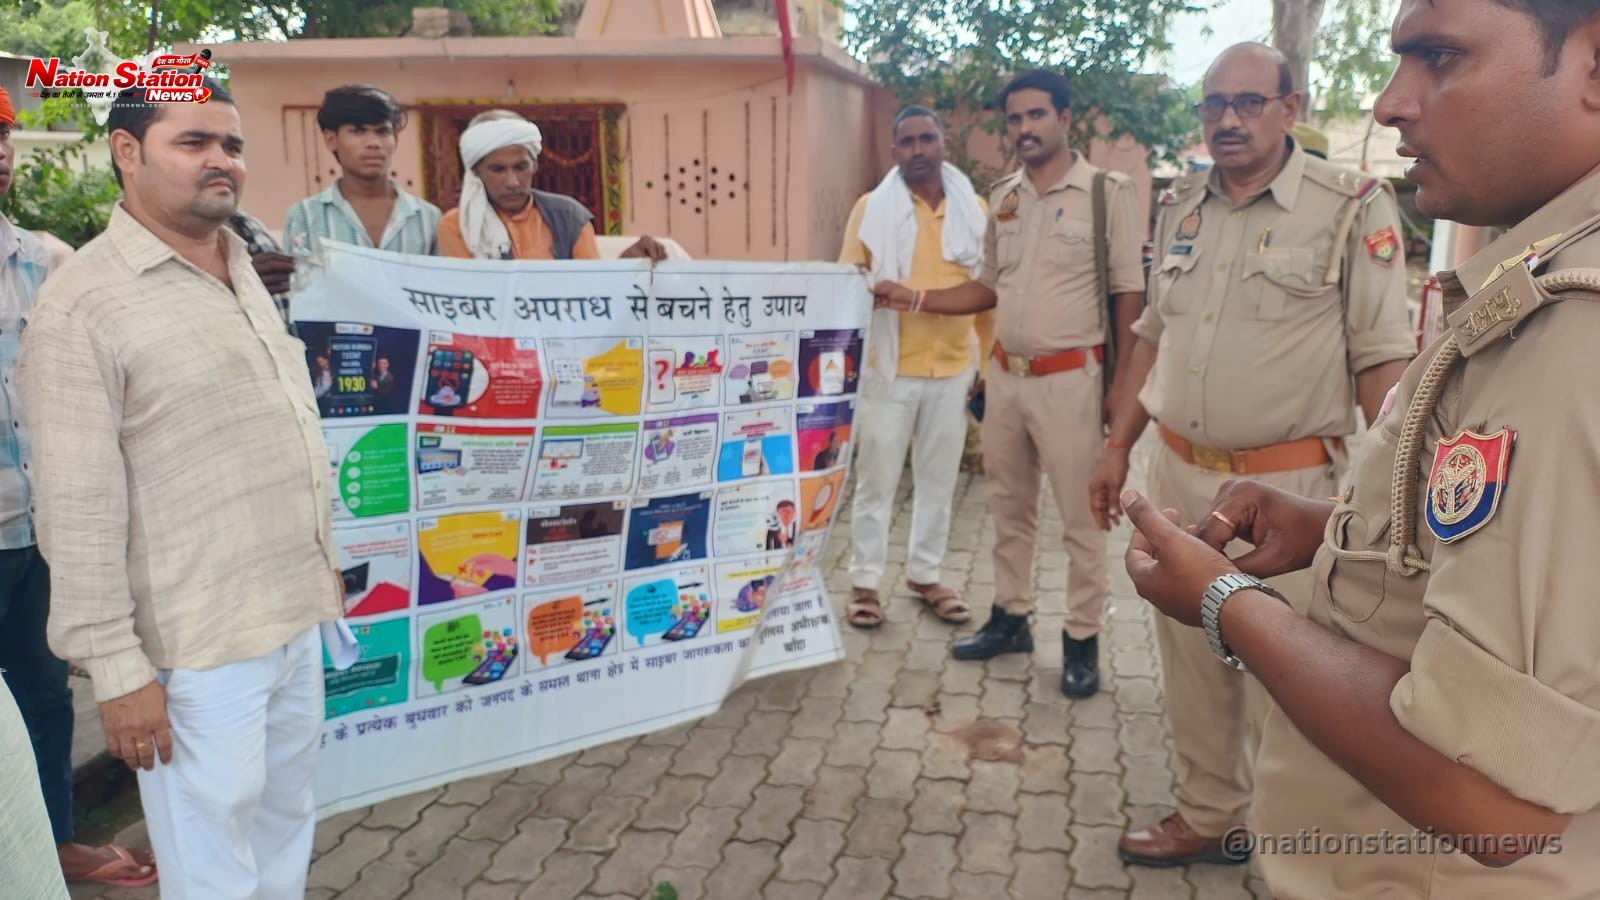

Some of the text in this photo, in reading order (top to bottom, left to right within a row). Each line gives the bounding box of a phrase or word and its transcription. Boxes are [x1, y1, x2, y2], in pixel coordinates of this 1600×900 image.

[402, 284, 807, 328] साइबर अपराध से बचने हेतु उपाय
[338, 375, 367, 392] 1930
[334, 721, 349, 741] के
[356, 715, 398, 736] प्रत्येक
[405, 704, 449, 730] बुधवार
[455, 693, 473, 713] को
[480, 687, 515, 707] जनपद
[520, 679, 533, 696] के
[539, 674, 570, 691] समस्त
[577, 667, 601, 684] थाना
[631, 656, 640, 671] में
[645, 652, 677, 669] साइबर
